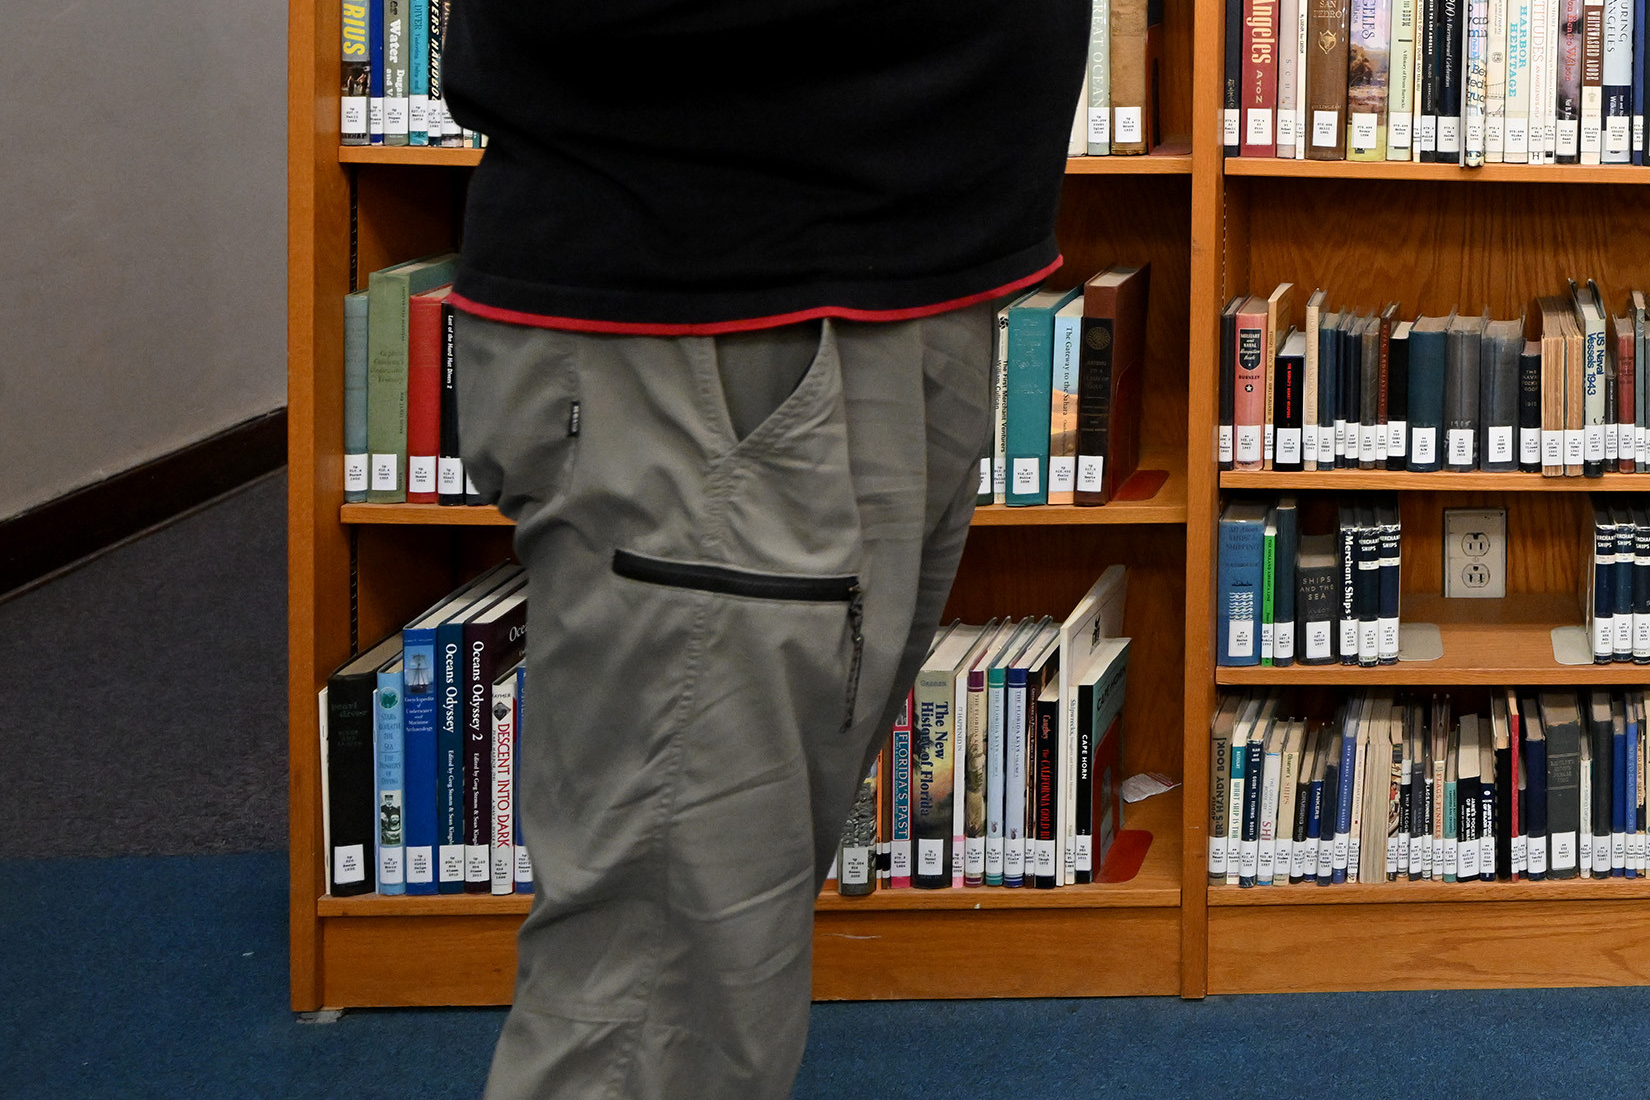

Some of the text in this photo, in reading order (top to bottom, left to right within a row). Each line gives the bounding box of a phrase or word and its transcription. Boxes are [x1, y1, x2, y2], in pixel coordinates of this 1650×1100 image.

[389, 19, 402, 64] Water
[1508, 23, 1518, 98] HERITAGE
[1519, 6, 1528, 68] HARBOR
[1092, 52, 1105, 107] OCEAN
[1587, 332, 1596, 396] Vessels 1943
[1596, 331, 1605, 375] US Naval
[1302, 576, 1331, 584] SHIPS
[1343, 536, 1354, 614] Merchant Ships
[443, 643, 458, 733] Oceans Odyssey
[919, 702, 935, 817] History of Florida
[934, 701, 949, 760] The New
[1080, 734, 1089, 780] CAPE HORN
[496, 723, 511, 849] DESCENT INTO DARK
[897, 733, 910, 837] FLORIDA'S PAST
[1216, 743, 1226, 812] HANDY BOOK
